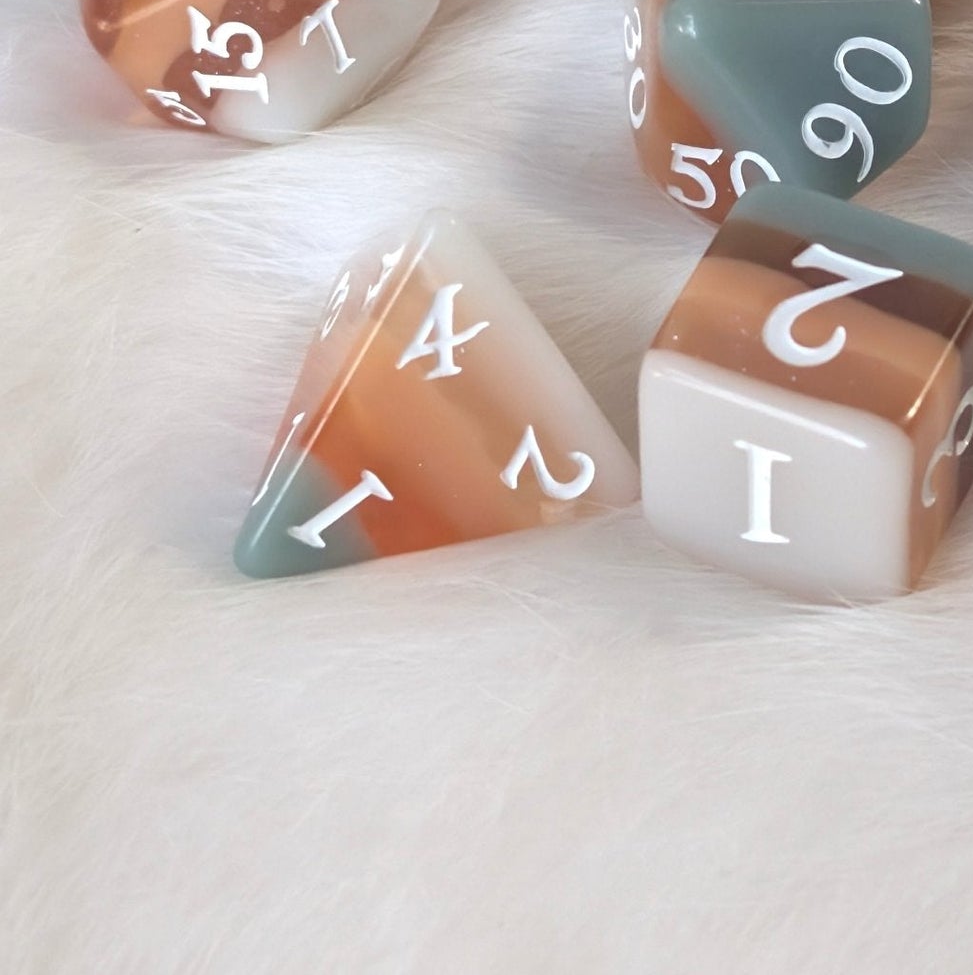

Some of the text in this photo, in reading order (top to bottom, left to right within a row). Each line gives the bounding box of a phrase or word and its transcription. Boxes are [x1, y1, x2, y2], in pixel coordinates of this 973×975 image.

[187, 6, 269, 104] 15
[301, 0, 356, 74] 7
[624, 7, 647, 129] 30
[802, 36, 913, 183] 90
[396, 283, 490, 380] 4
[763, 243, 904, 366] 2
[288, 470, 393, 549] 1
[500, 425, 595, 500] 2
[733, 440, 792, 543] 1
